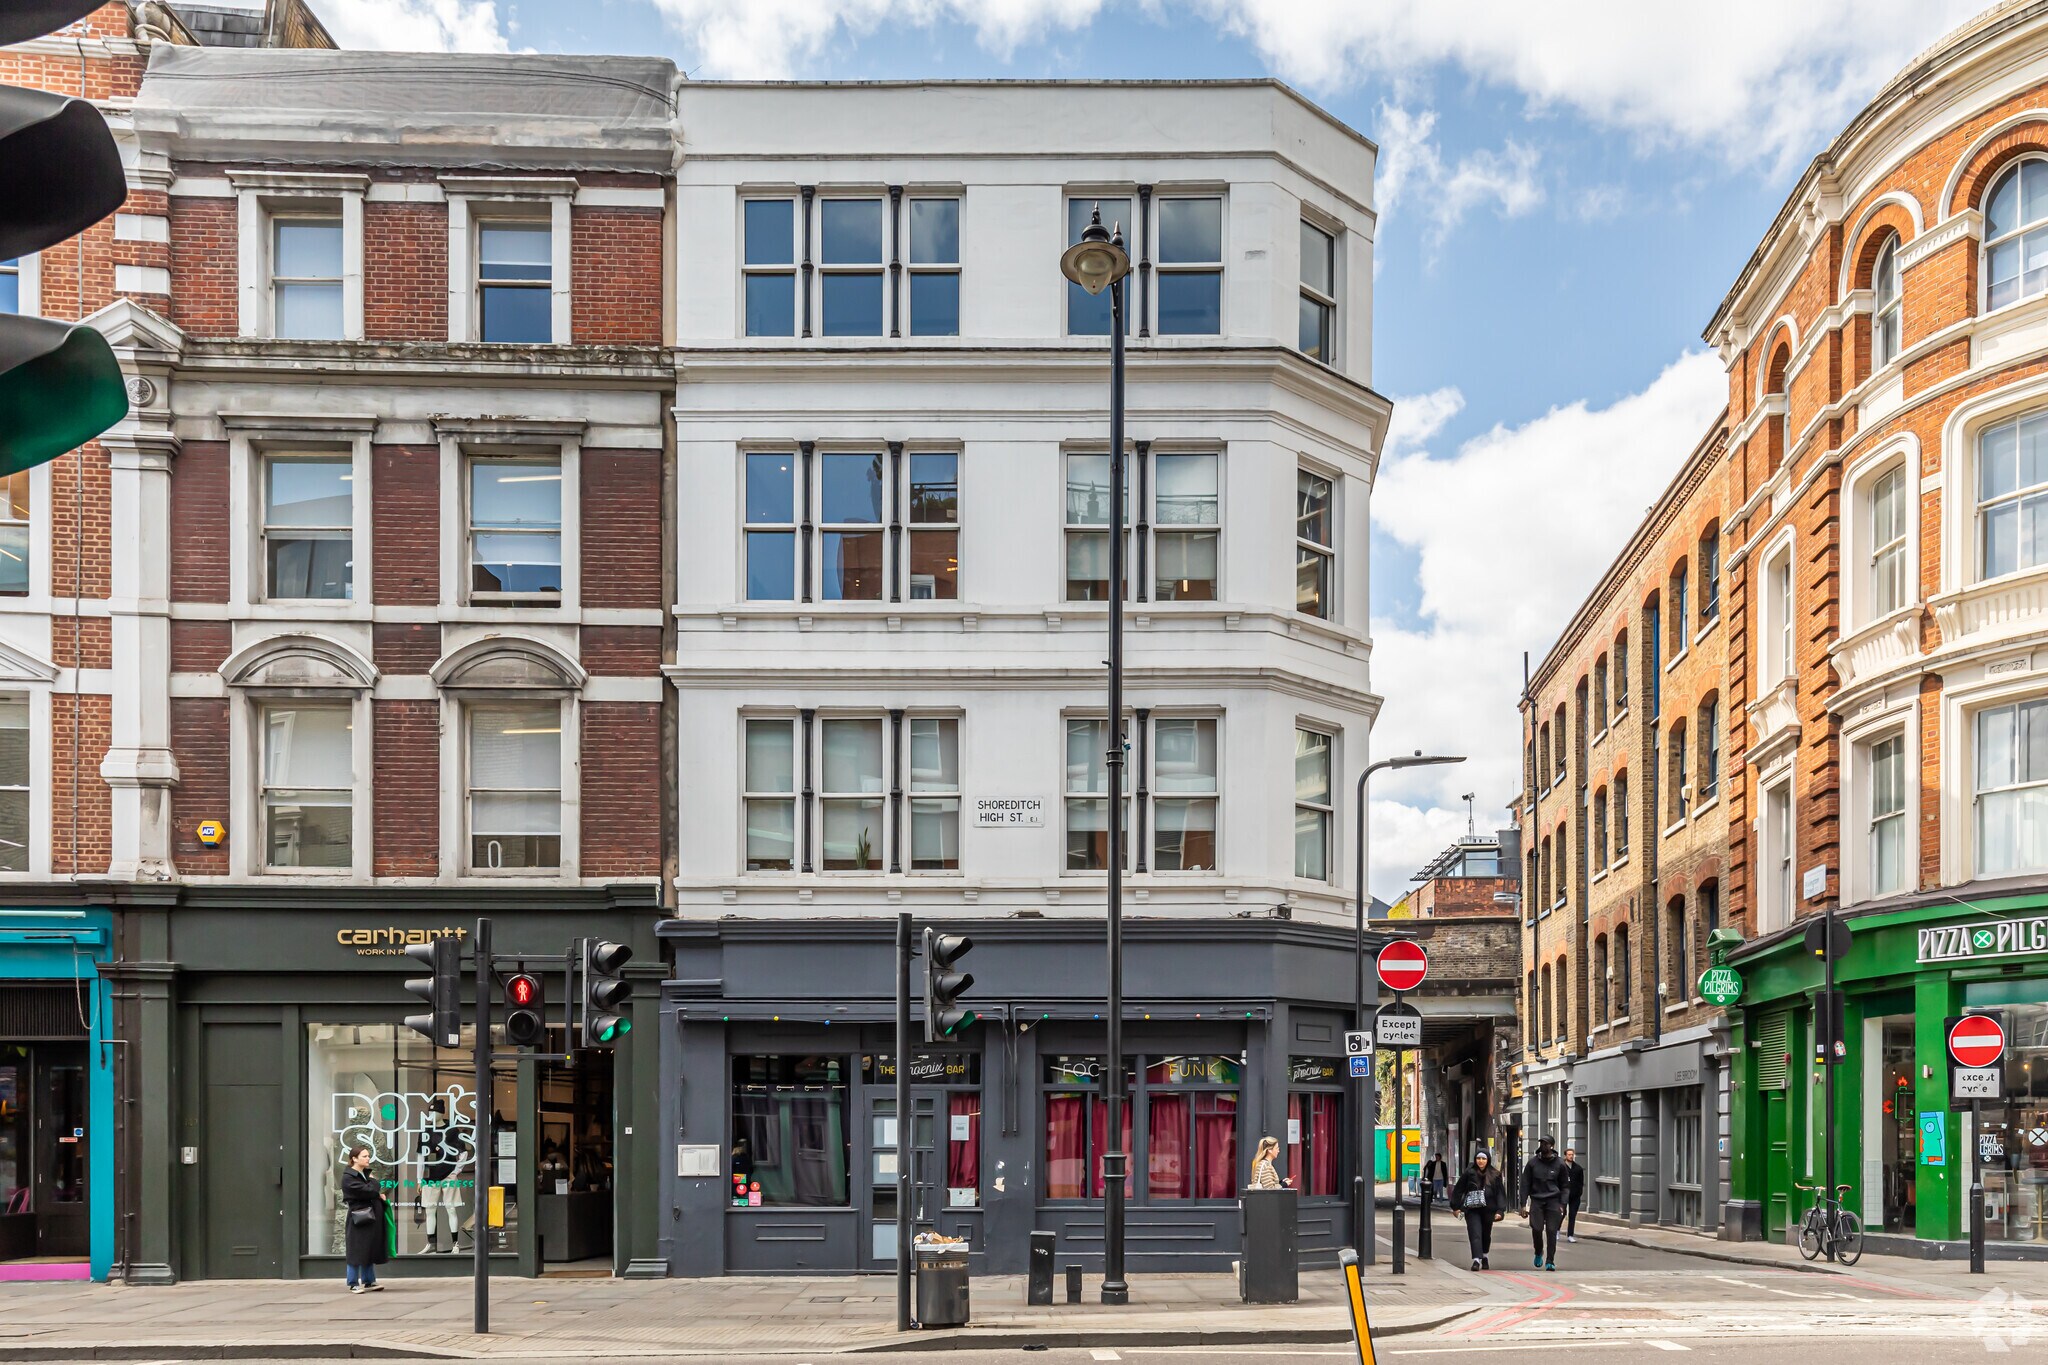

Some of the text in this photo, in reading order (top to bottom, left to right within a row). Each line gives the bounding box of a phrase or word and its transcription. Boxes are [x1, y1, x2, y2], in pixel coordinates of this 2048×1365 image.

[978, 800, 1041, 810] SHOREDITCH
[979, 812, 1004, 822] HIGH
[1009, 812, 1024, 822] ST.
[202, 827, 214, 835] ADT
[1918, 919, 2048, 960] PIZZA PILG
[356, 948, 386, 956] WORK
[386, 948, 397, 956] IN
[1712, 970, 1732, 981] PIZZA
[1704, 981, 1739, 995] PILGRIMS
[1382, 1019, 1416, 1029] Except
[880, 1065, 896, 1075] THE
[946, 1064, 965, 1075] BAR
[1169, 1062, 1217, 1077] FUNK
[1322, 1067, 1335, 1077] BAR
[1980, 1134, 1997, 1144] PIZZA
[338, 1125, 477, 1165] SUBS
[1980, 1144, 2004, 1155] LGRIMS
